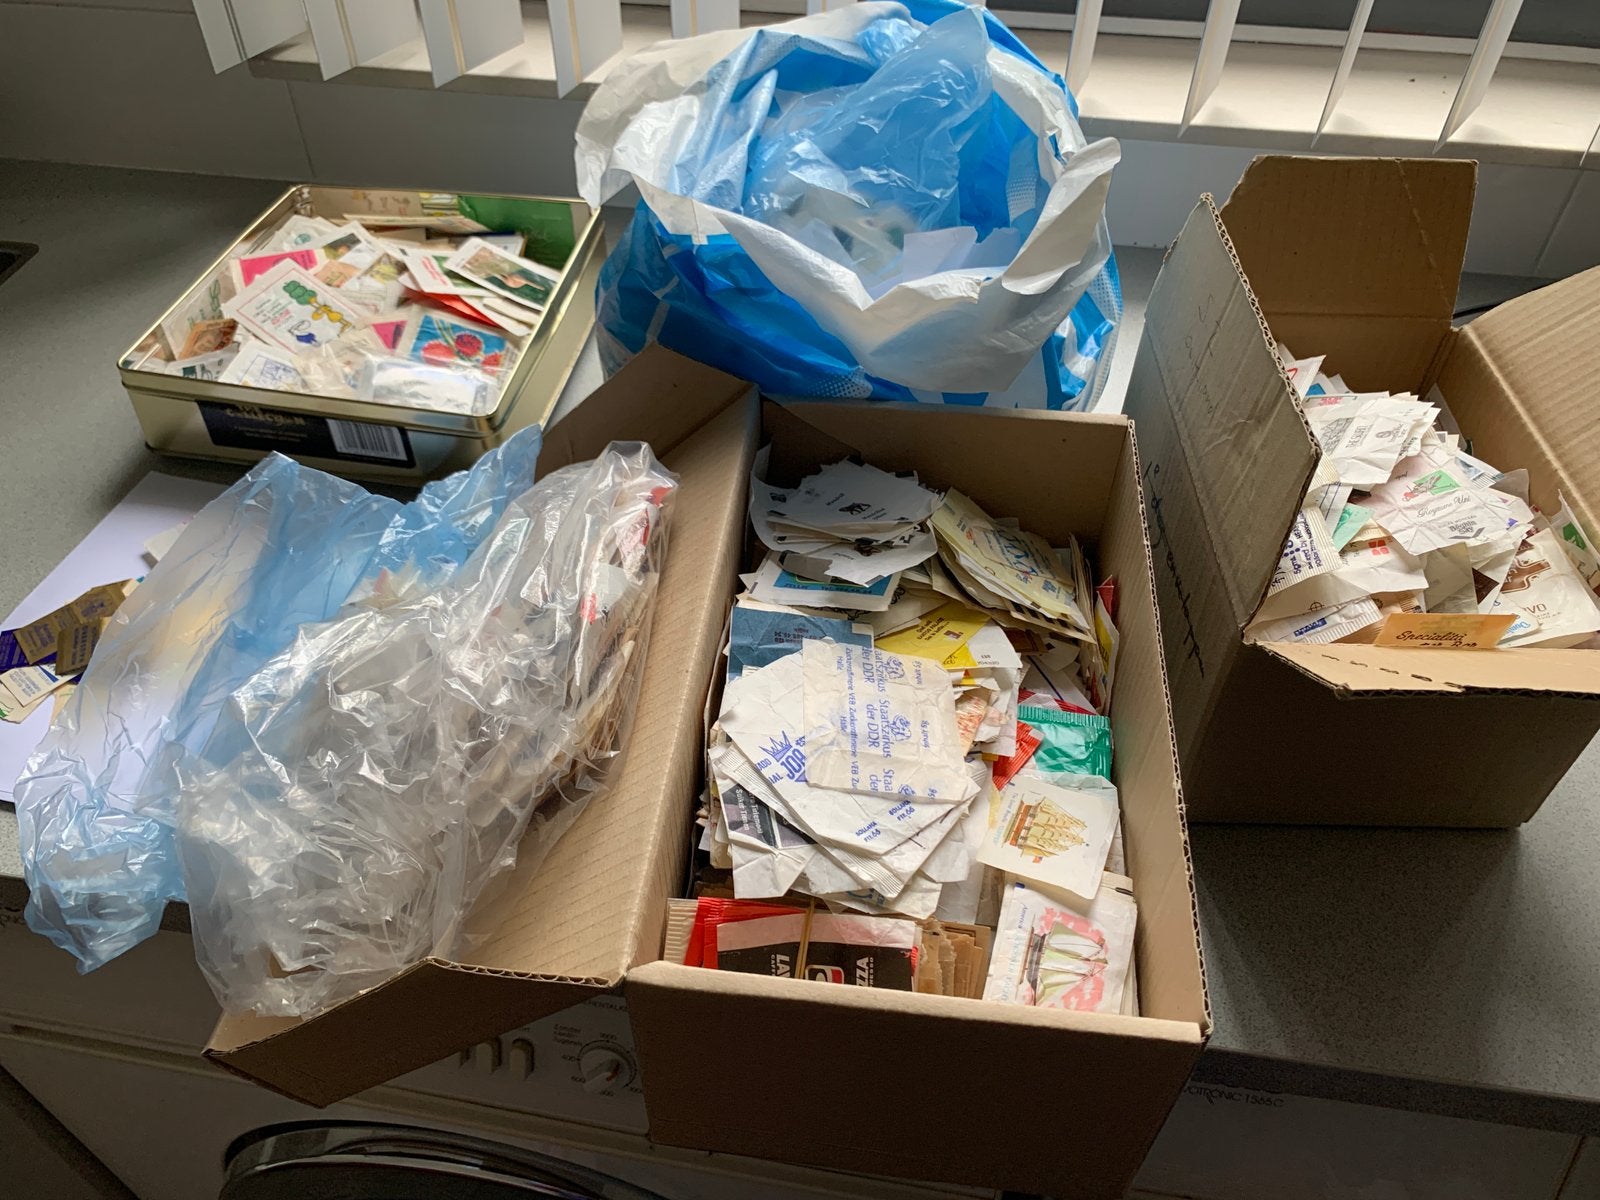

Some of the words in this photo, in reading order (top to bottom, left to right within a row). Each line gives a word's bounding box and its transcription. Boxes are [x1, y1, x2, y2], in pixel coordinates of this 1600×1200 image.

[862, 662, 875, 684] DDR
[848, 692, 857, 705] VEB
[865, 703, 877, 720] der
[867, 723, 880, 748] DDR
[878, 699, 894, 759] Staatszirkus
[850, 761, 860, 775] VEB
[1017, 903, 1029, 929] America
